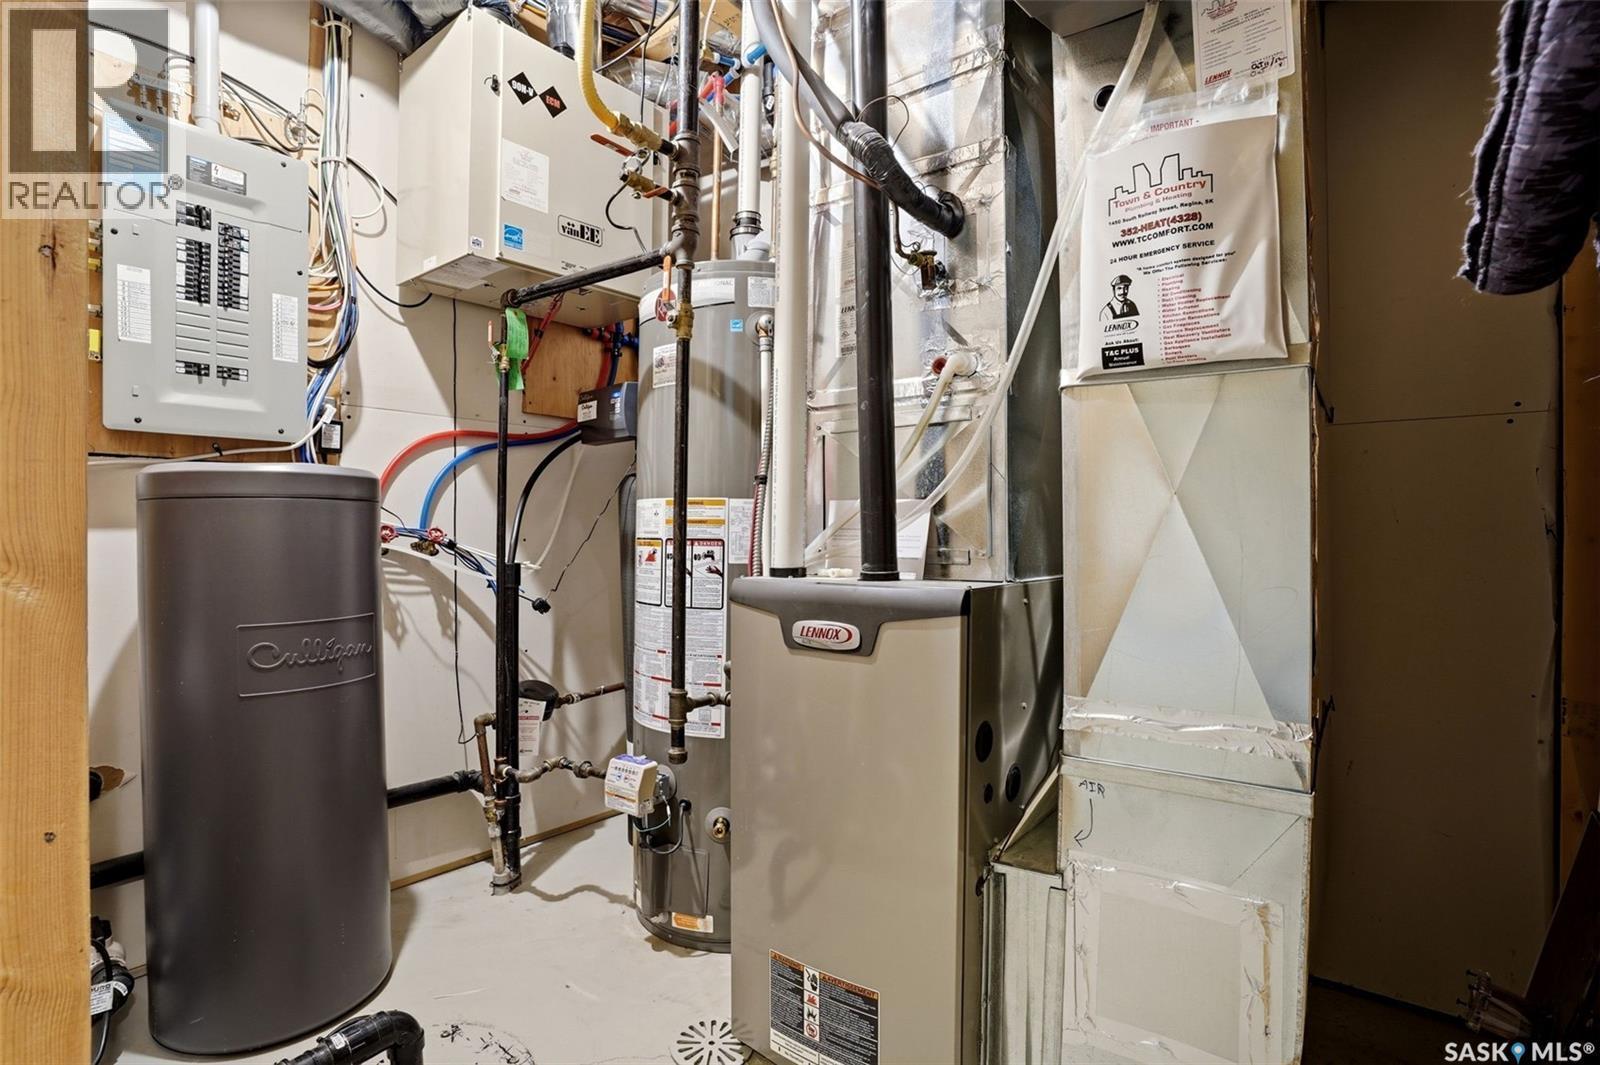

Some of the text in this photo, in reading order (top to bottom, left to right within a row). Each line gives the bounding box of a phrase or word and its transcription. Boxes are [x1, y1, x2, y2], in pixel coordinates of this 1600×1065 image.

[1150, 118, 1194, 133] IMPORTANT
[1113, 180, 1207, 209] Town & Country
[1162, 191, 1193, 202] Heating
[1120, 211, 1203, 238] 352-HEAT(4328)
[1112, 222, 1214, 249] WWW.TCCOMFORT.COM
[1109, 239, 1216, 265] 24 HOUR EMERGENCY SERVICE
[1104, 322, 1132, 332] LENNOX
[1120, 347, 1139, 355] PLUS
[800, 625, 842, 640] LENNOX
[247, 637, 372, 672] Culligan
[1078, 780, 1106, 799] AIR
